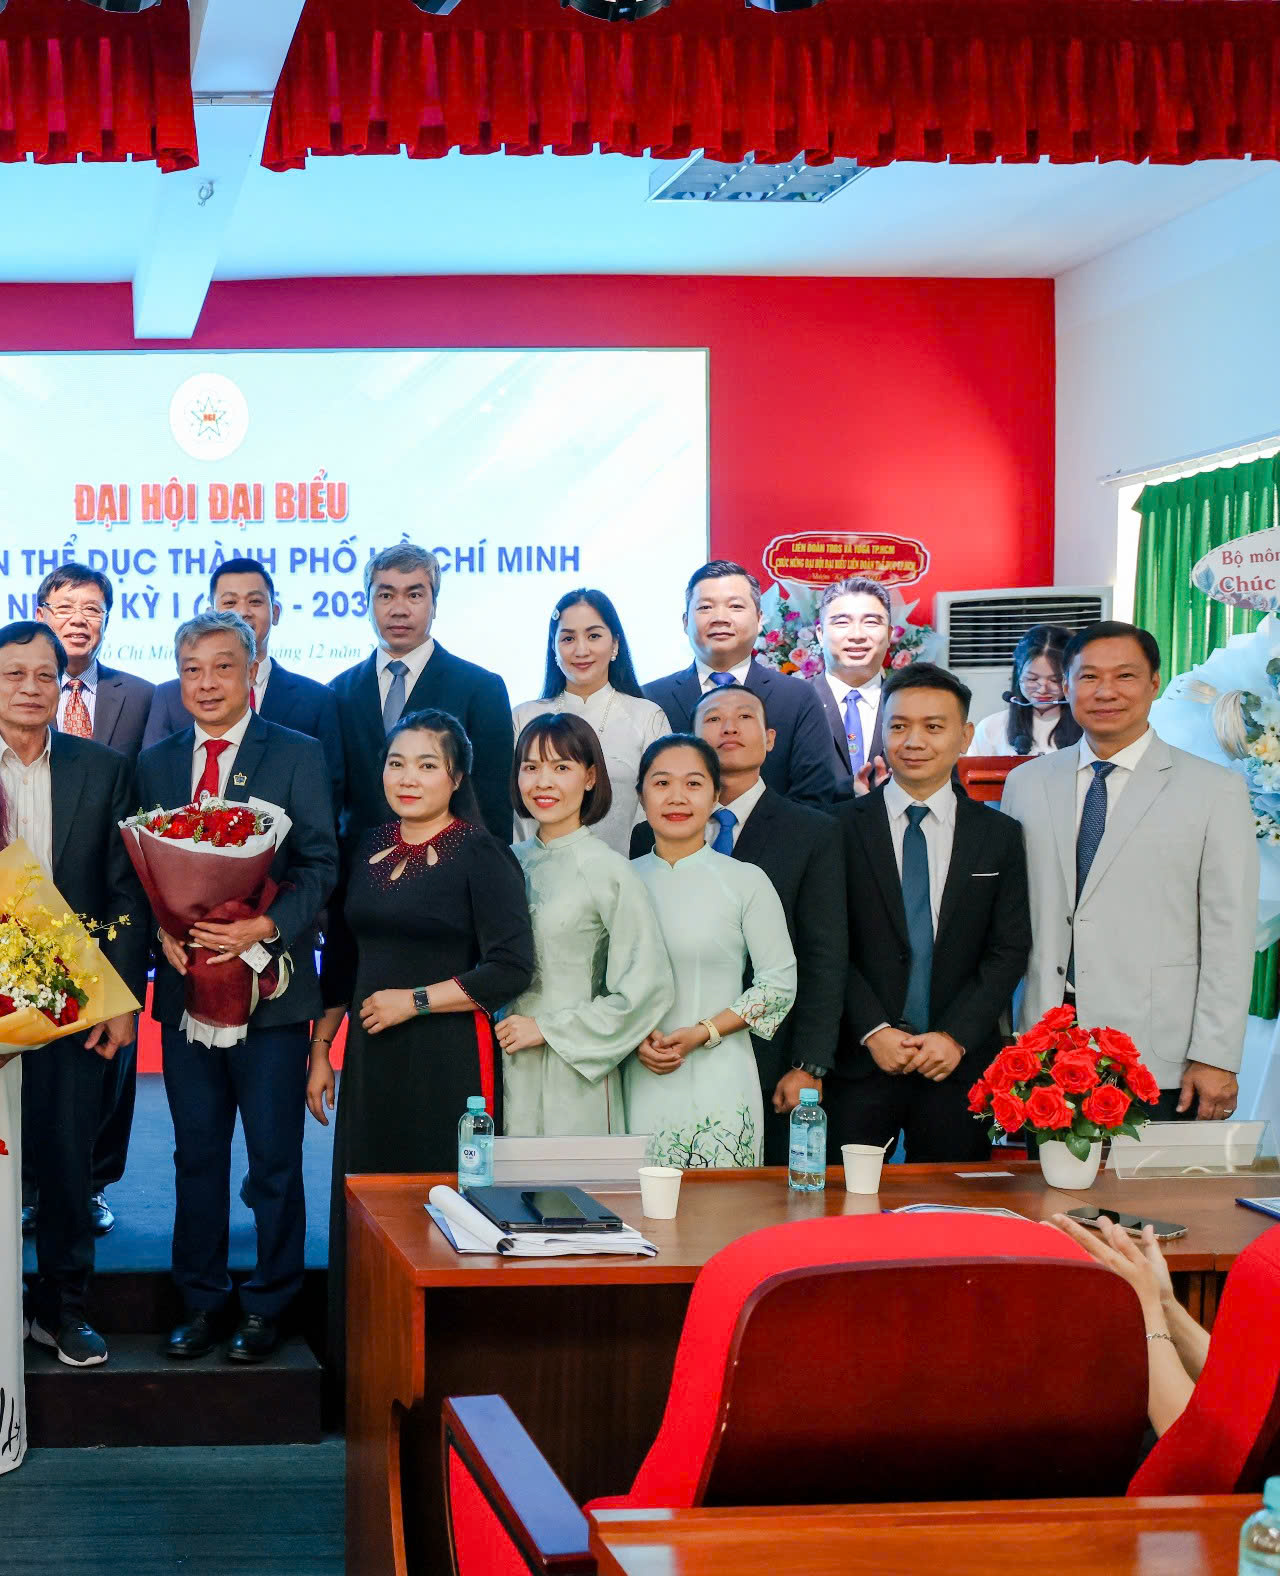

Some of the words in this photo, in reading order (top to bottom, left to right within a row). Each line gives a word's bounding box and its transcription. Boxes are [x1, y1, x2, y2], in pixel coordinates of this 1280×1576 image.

[73, 482, 130, 530] ĐẠI
[141, 476, 198, 529] HỘI
[208, 482, 265, 529] ĐẠI
[274, 468, 349, 522] BIỂU
[21, 533, 78, 576] THỂ
[88, 548, 158, 584] DỤC
[289, 535, 357, 574] PHỐ
[497, 545, 580, 573] MINH
[1221, 550, 1244, 568] Bộ
[121, 584, 160, 619] KỲ
[173, 592, 179, 619] I
[312, 588, 368, 618] 203
[1219, 575, 1276, 593] Chúc
